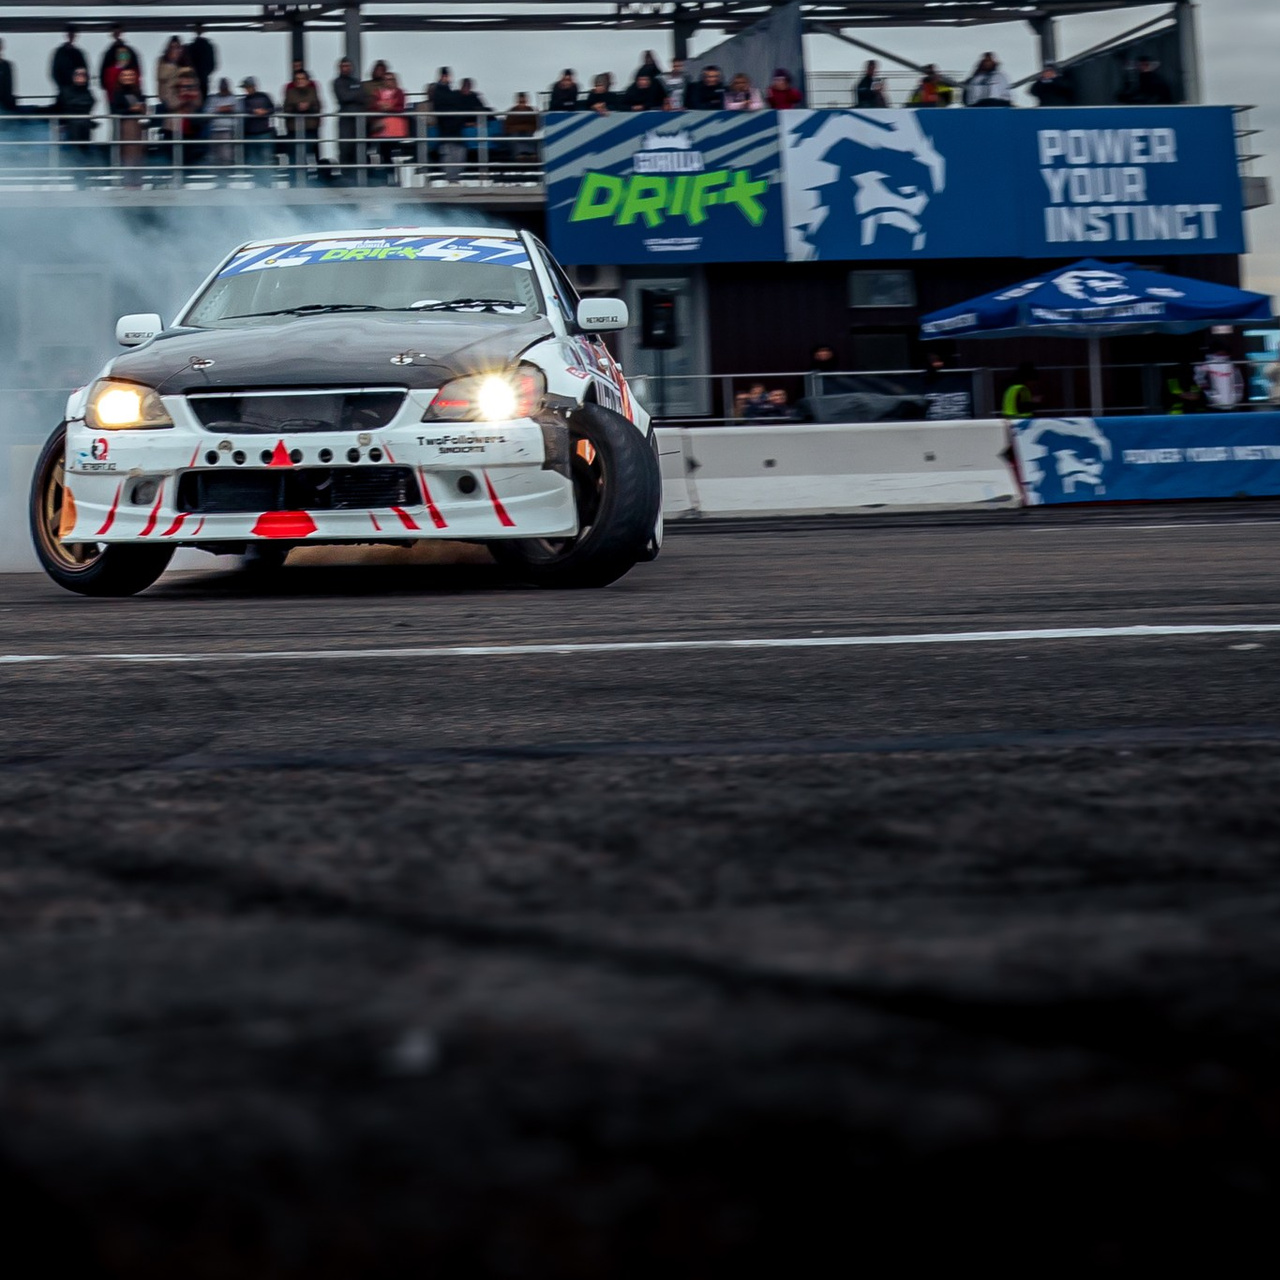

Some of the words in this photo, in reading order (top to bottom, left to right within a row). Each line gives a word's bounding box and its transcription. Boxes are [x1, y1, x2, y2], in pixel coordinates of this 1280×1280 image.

[1037, 127, 1178, 165] POWER
[633, 151, 705, 173] GORILLA
[569, 170, 769, 228] DRIFT
[1039, 166, 1148, 203] YOUR
[1043, 204, 1222, 243] INSTINCT
[320, 244, 421, 260] DRIFT
[586, 316, 619, 324] RETROFIT.KZ
[416, 435, 506, 446] TwoFollowers
